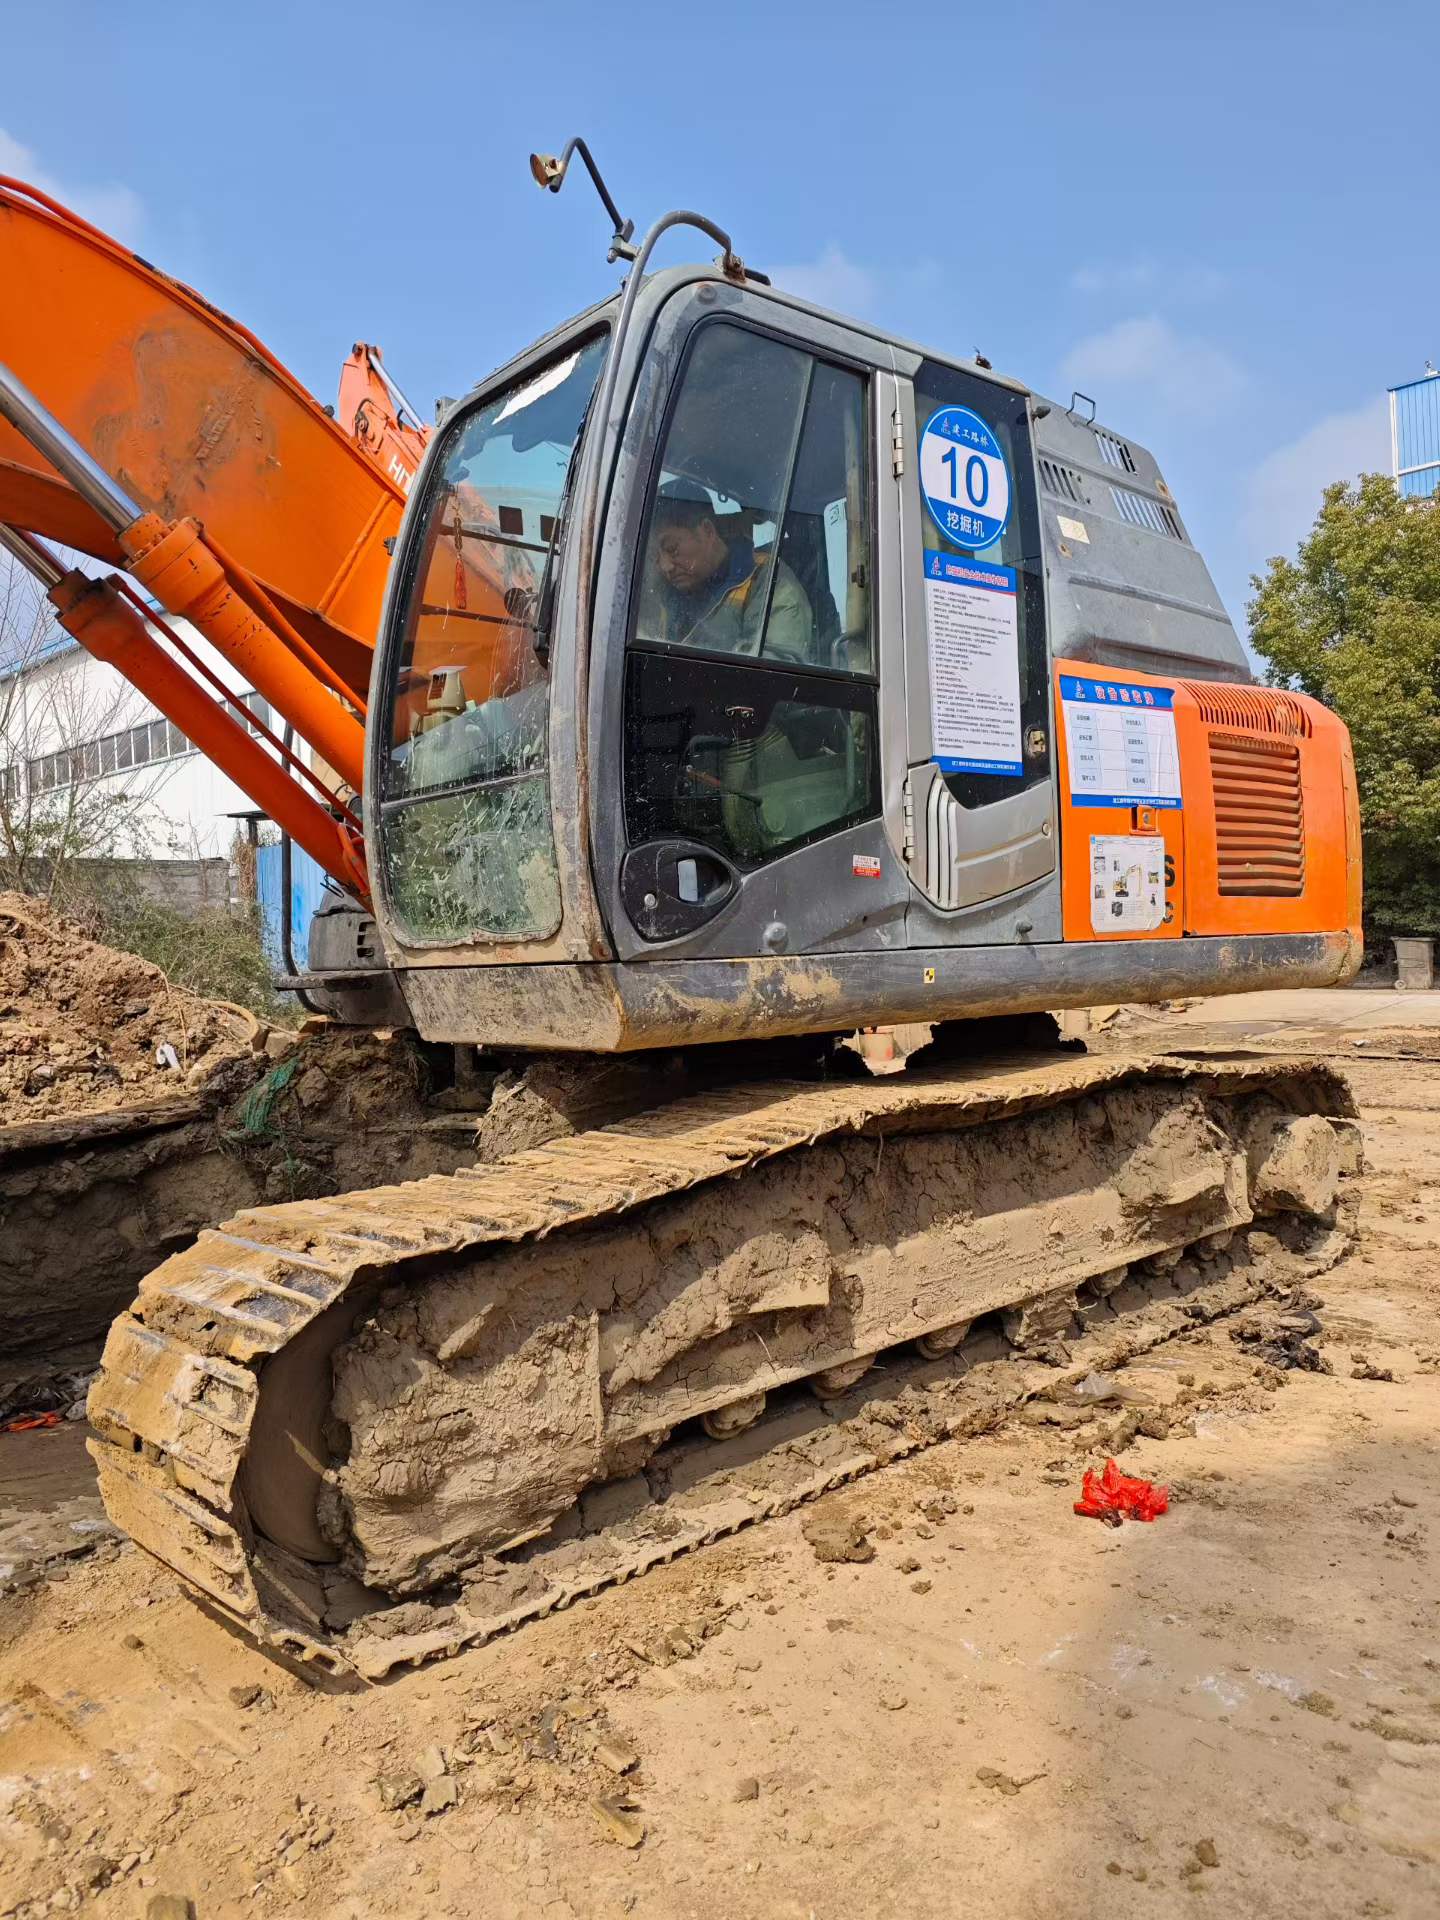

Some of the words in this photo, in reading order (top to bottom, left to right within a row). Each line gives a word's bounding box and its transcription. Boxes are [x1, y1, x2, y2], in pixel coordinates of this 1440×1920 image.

[951, 423, 990, 448] 建工路桥
[941, 446, 989, 508] 10
[946, 509, 985, 538] 挖掘机
